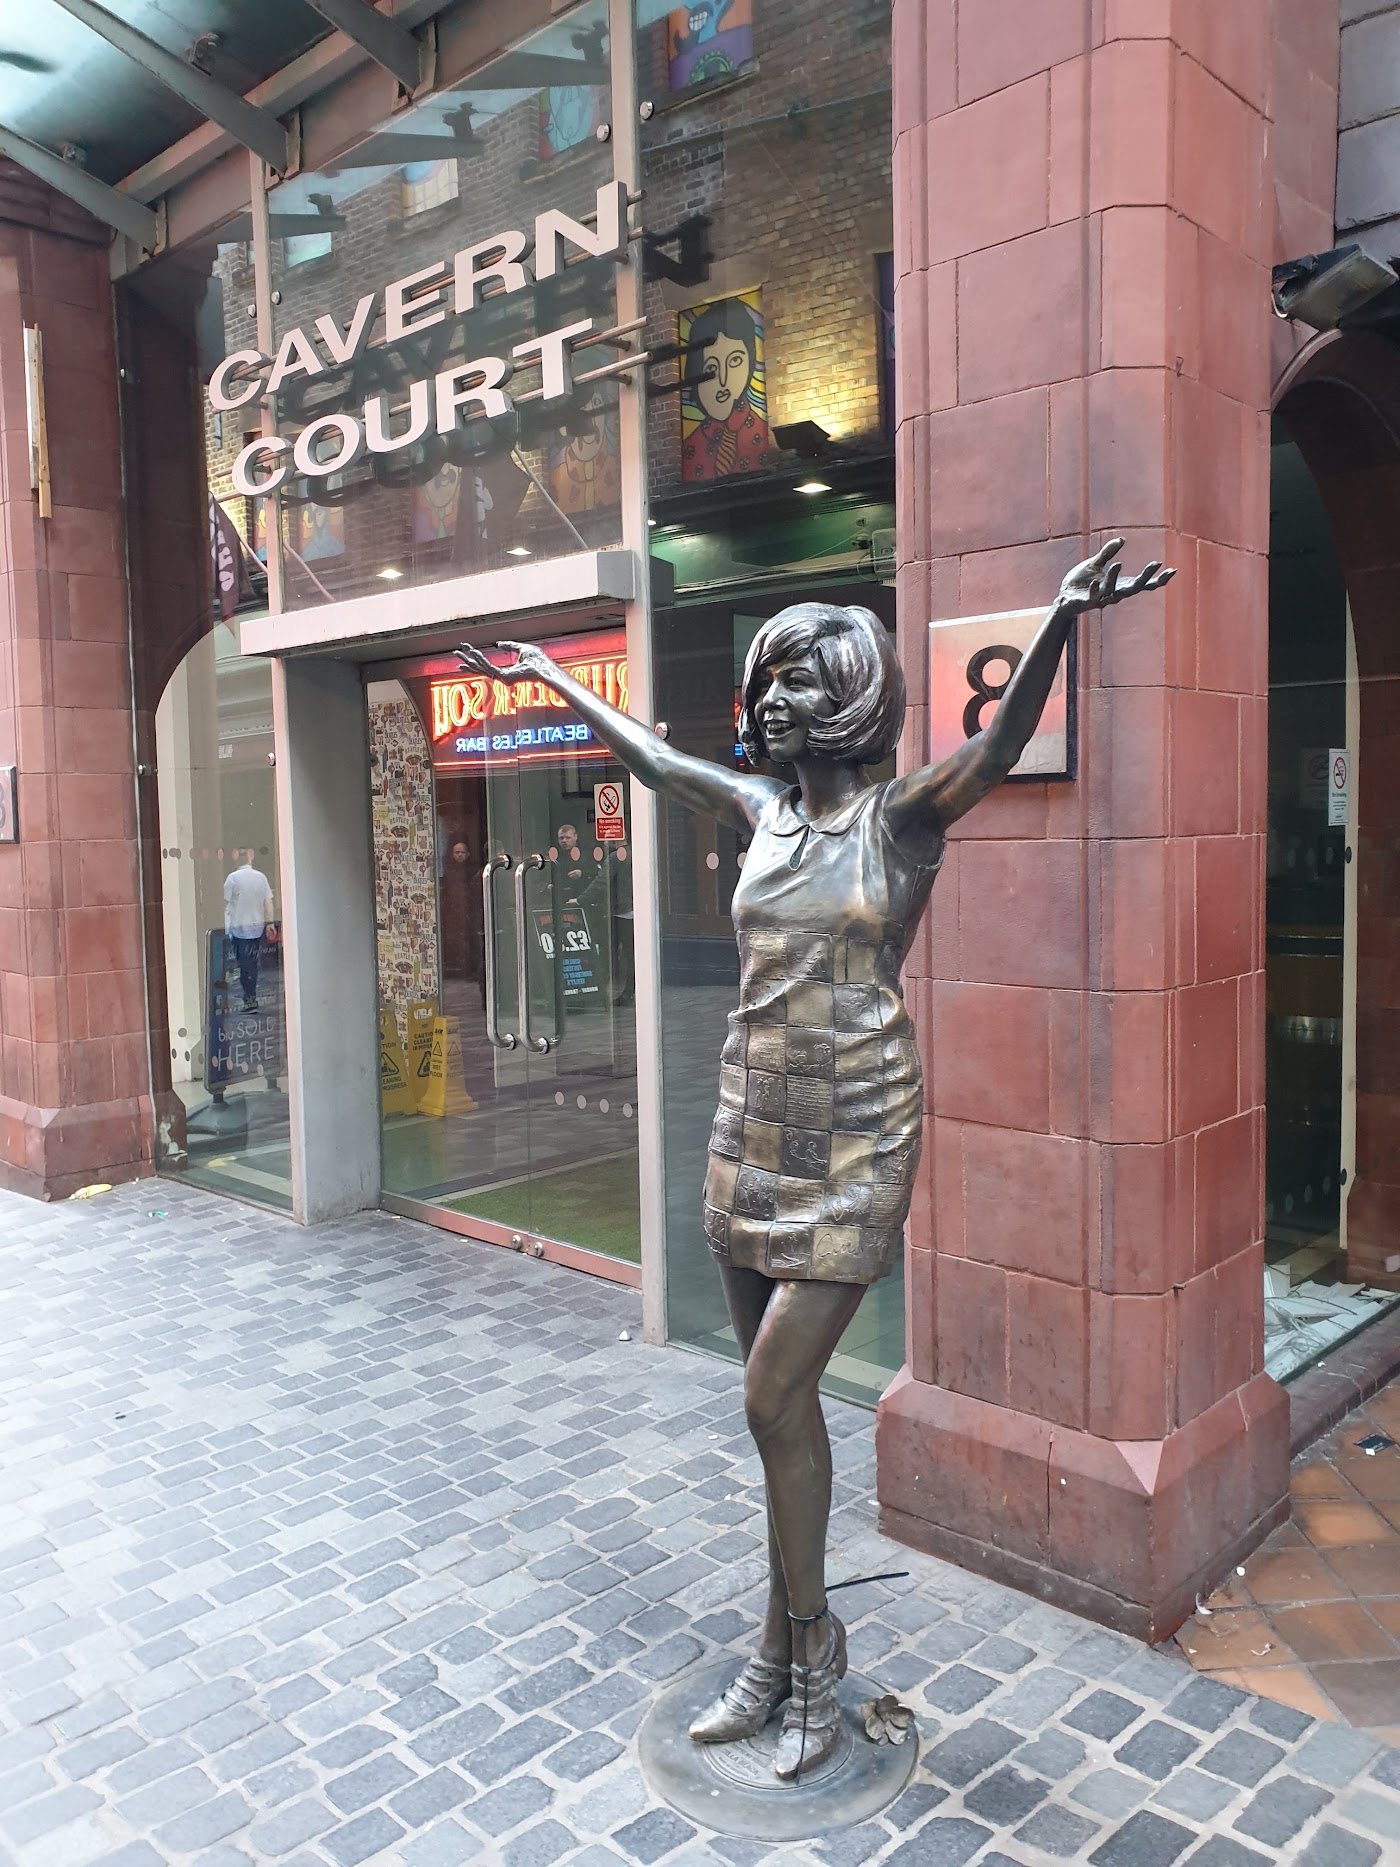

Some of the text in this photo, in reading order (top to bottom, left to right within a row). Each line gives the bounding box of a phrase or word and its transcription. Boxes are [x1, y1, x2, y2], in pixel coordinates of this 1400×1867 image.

[208, 180, 627, 411] CAVERN
[232, 318, 593, 497] COURT
[218, 1036, 275, 1071] HERE
